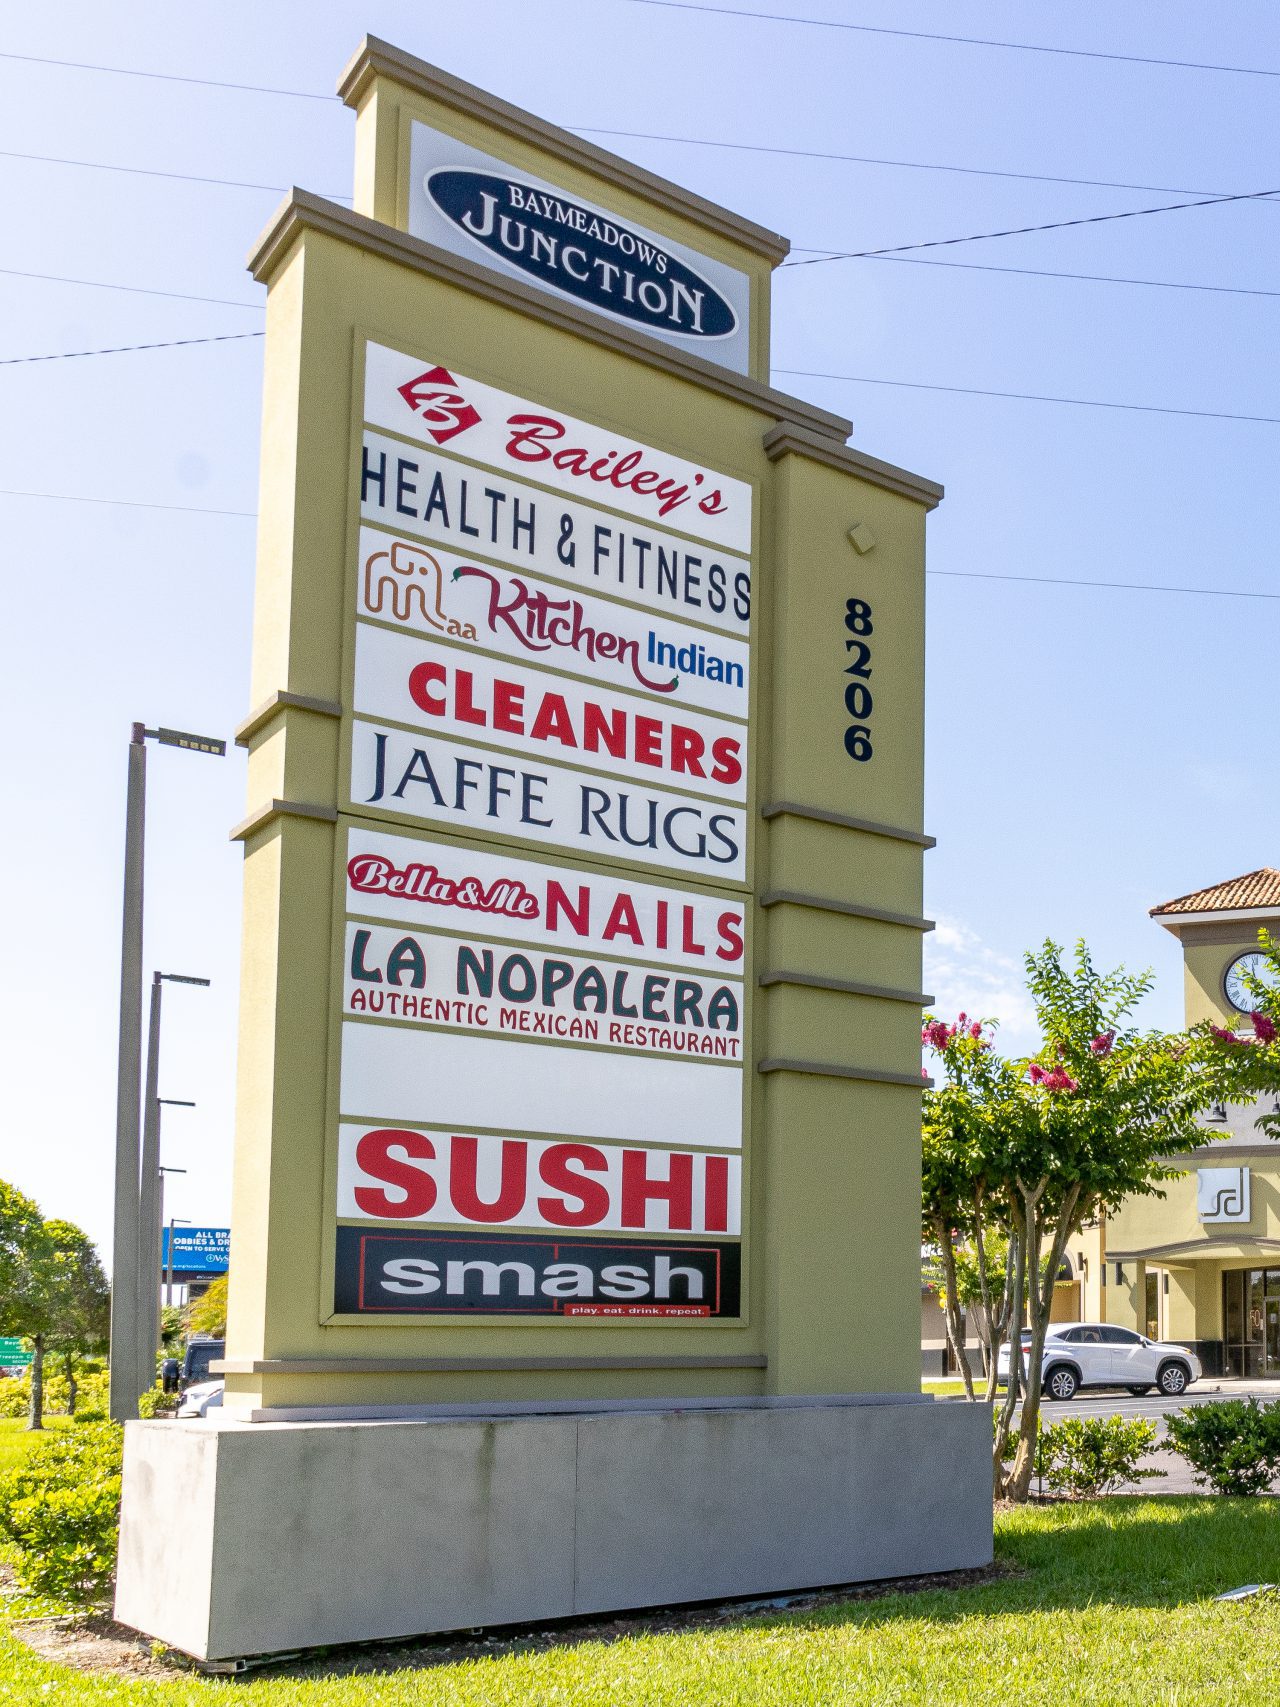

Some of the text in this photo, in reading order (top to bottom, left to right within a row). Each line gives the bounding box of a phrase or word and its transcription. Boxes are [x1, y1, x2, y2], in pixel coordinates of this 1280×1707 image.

[461, 192, 706, 333] JUNCTION
[508, 185, 668, 275] BAYMEADOWS
[505, 414, 728, 517] Bailey's
[361, 446, 751, 622] HEALTH & FITNESS
[451, 566, 679, 693] Kitchen
[647, 631, 744, 689] Indian
[844, 598, 874, 762] 8206
[408, 661, 743, 785] CLEANERS
[365, 732, 740, 864] JAFFE RUGS
[546, 880, 744, 962] NAILS
[350, 988, 740, 1058] AUTHENTIC MEXICAN RESTAURANT
[351, 929, 740, 1032] LA NOPALERA
[354, 1129, 729, 1232] SUSHI
[380, 1256, 704, 1299] smash
[572, 1307, 600, 1315] play.
[629, 1307, 662, 1315] drink.
